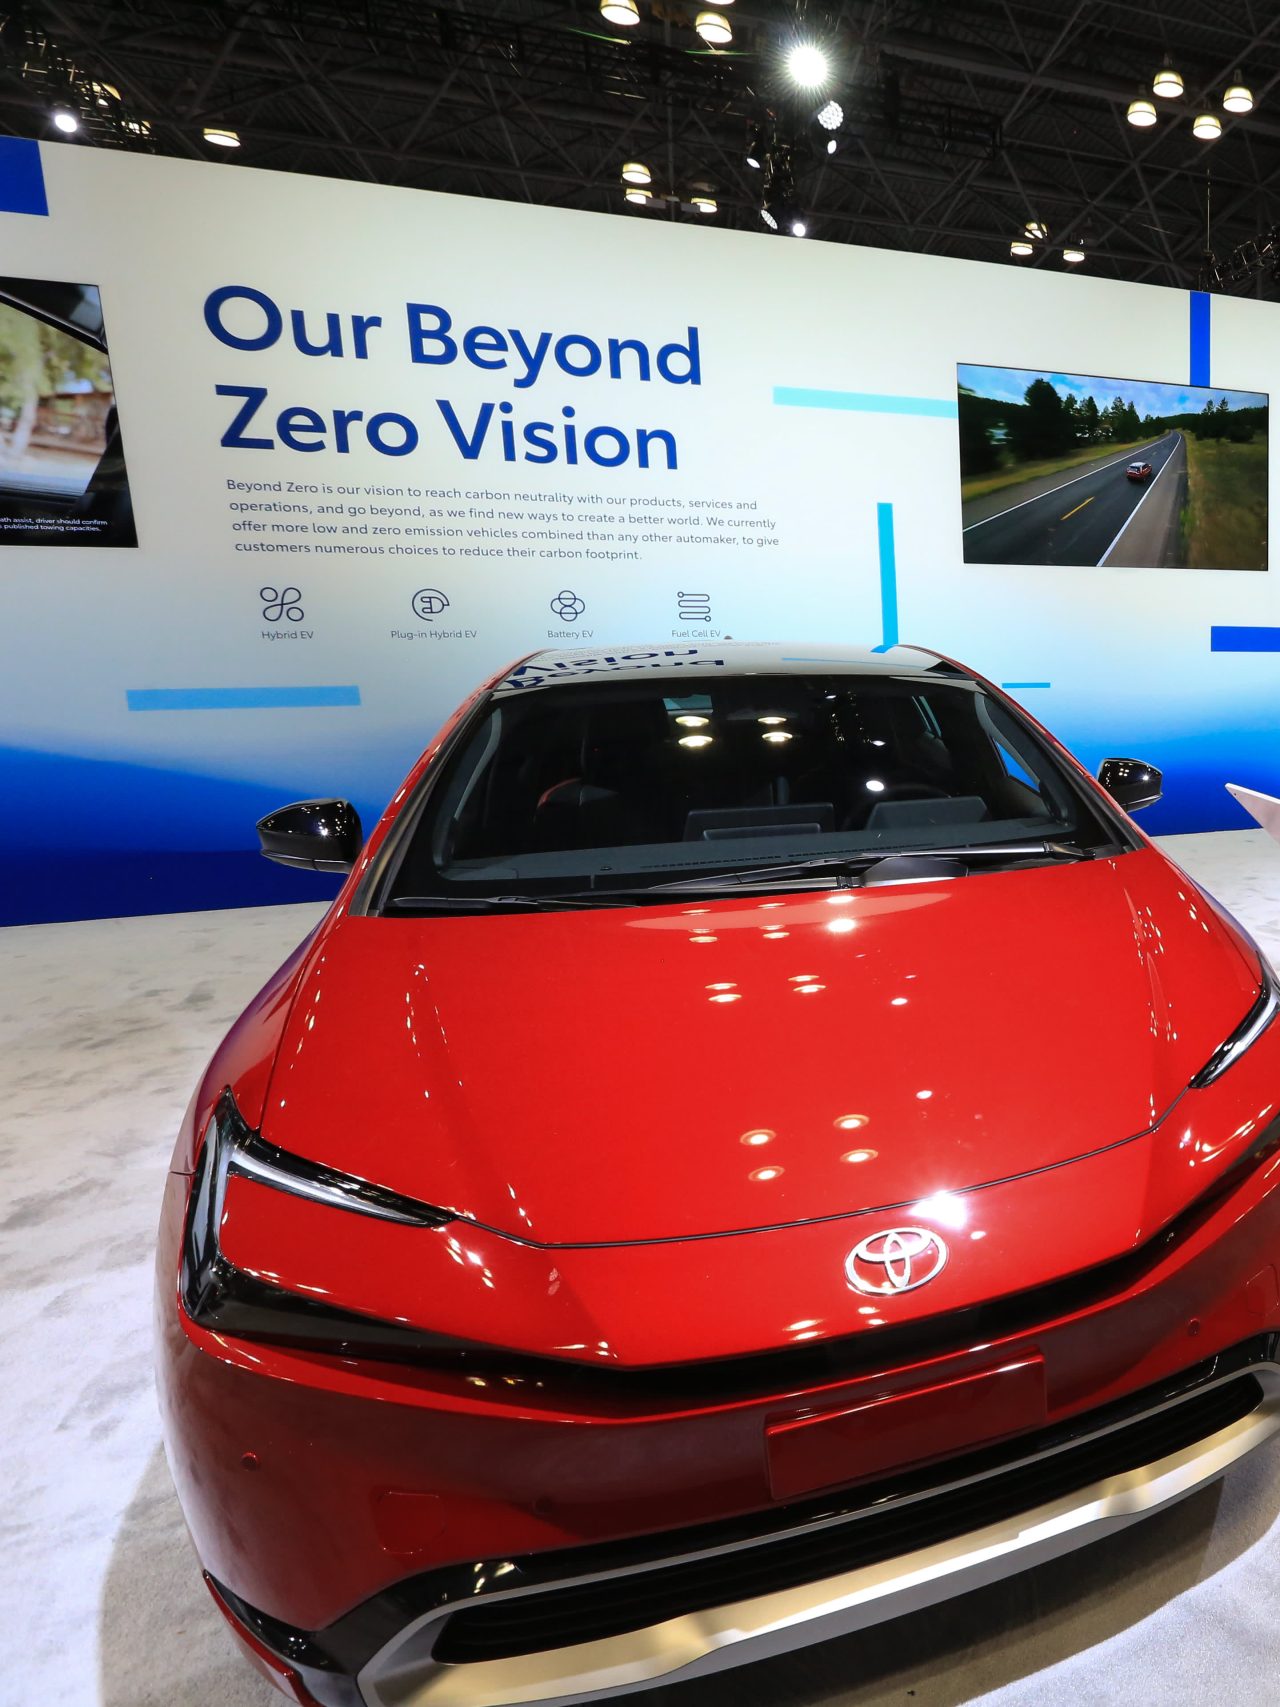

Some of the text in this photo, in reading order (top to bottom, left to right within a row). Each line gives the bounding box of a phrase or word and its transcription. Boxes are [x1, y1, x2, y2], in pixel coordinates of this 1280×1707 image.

[203, 285, 702, 388] Our Beyond
[214, 383, 679, 470] Zero Vision
[226, 479, 757, 510] Beyond Zero is our vision to reach carbon neutrality with our products, services and
[229, 501, 776, 530] operations, and go beyond, as we find new ways to create a better world. We currently
[231, 520, 779, 548] offer more low and zero emission vehicles combined than any other automaker, to give
[234, 542, 642, 561] customers numerous choices to reduce their carbon footprint.
[261, 631, 314, 641] Hybrid EV
[391, 630, 478, 641] Plug-in Hybrid EV
[547, 629, 594, 640] Battery EV
[671, 629, 721, 638] Fuel Cell EV
